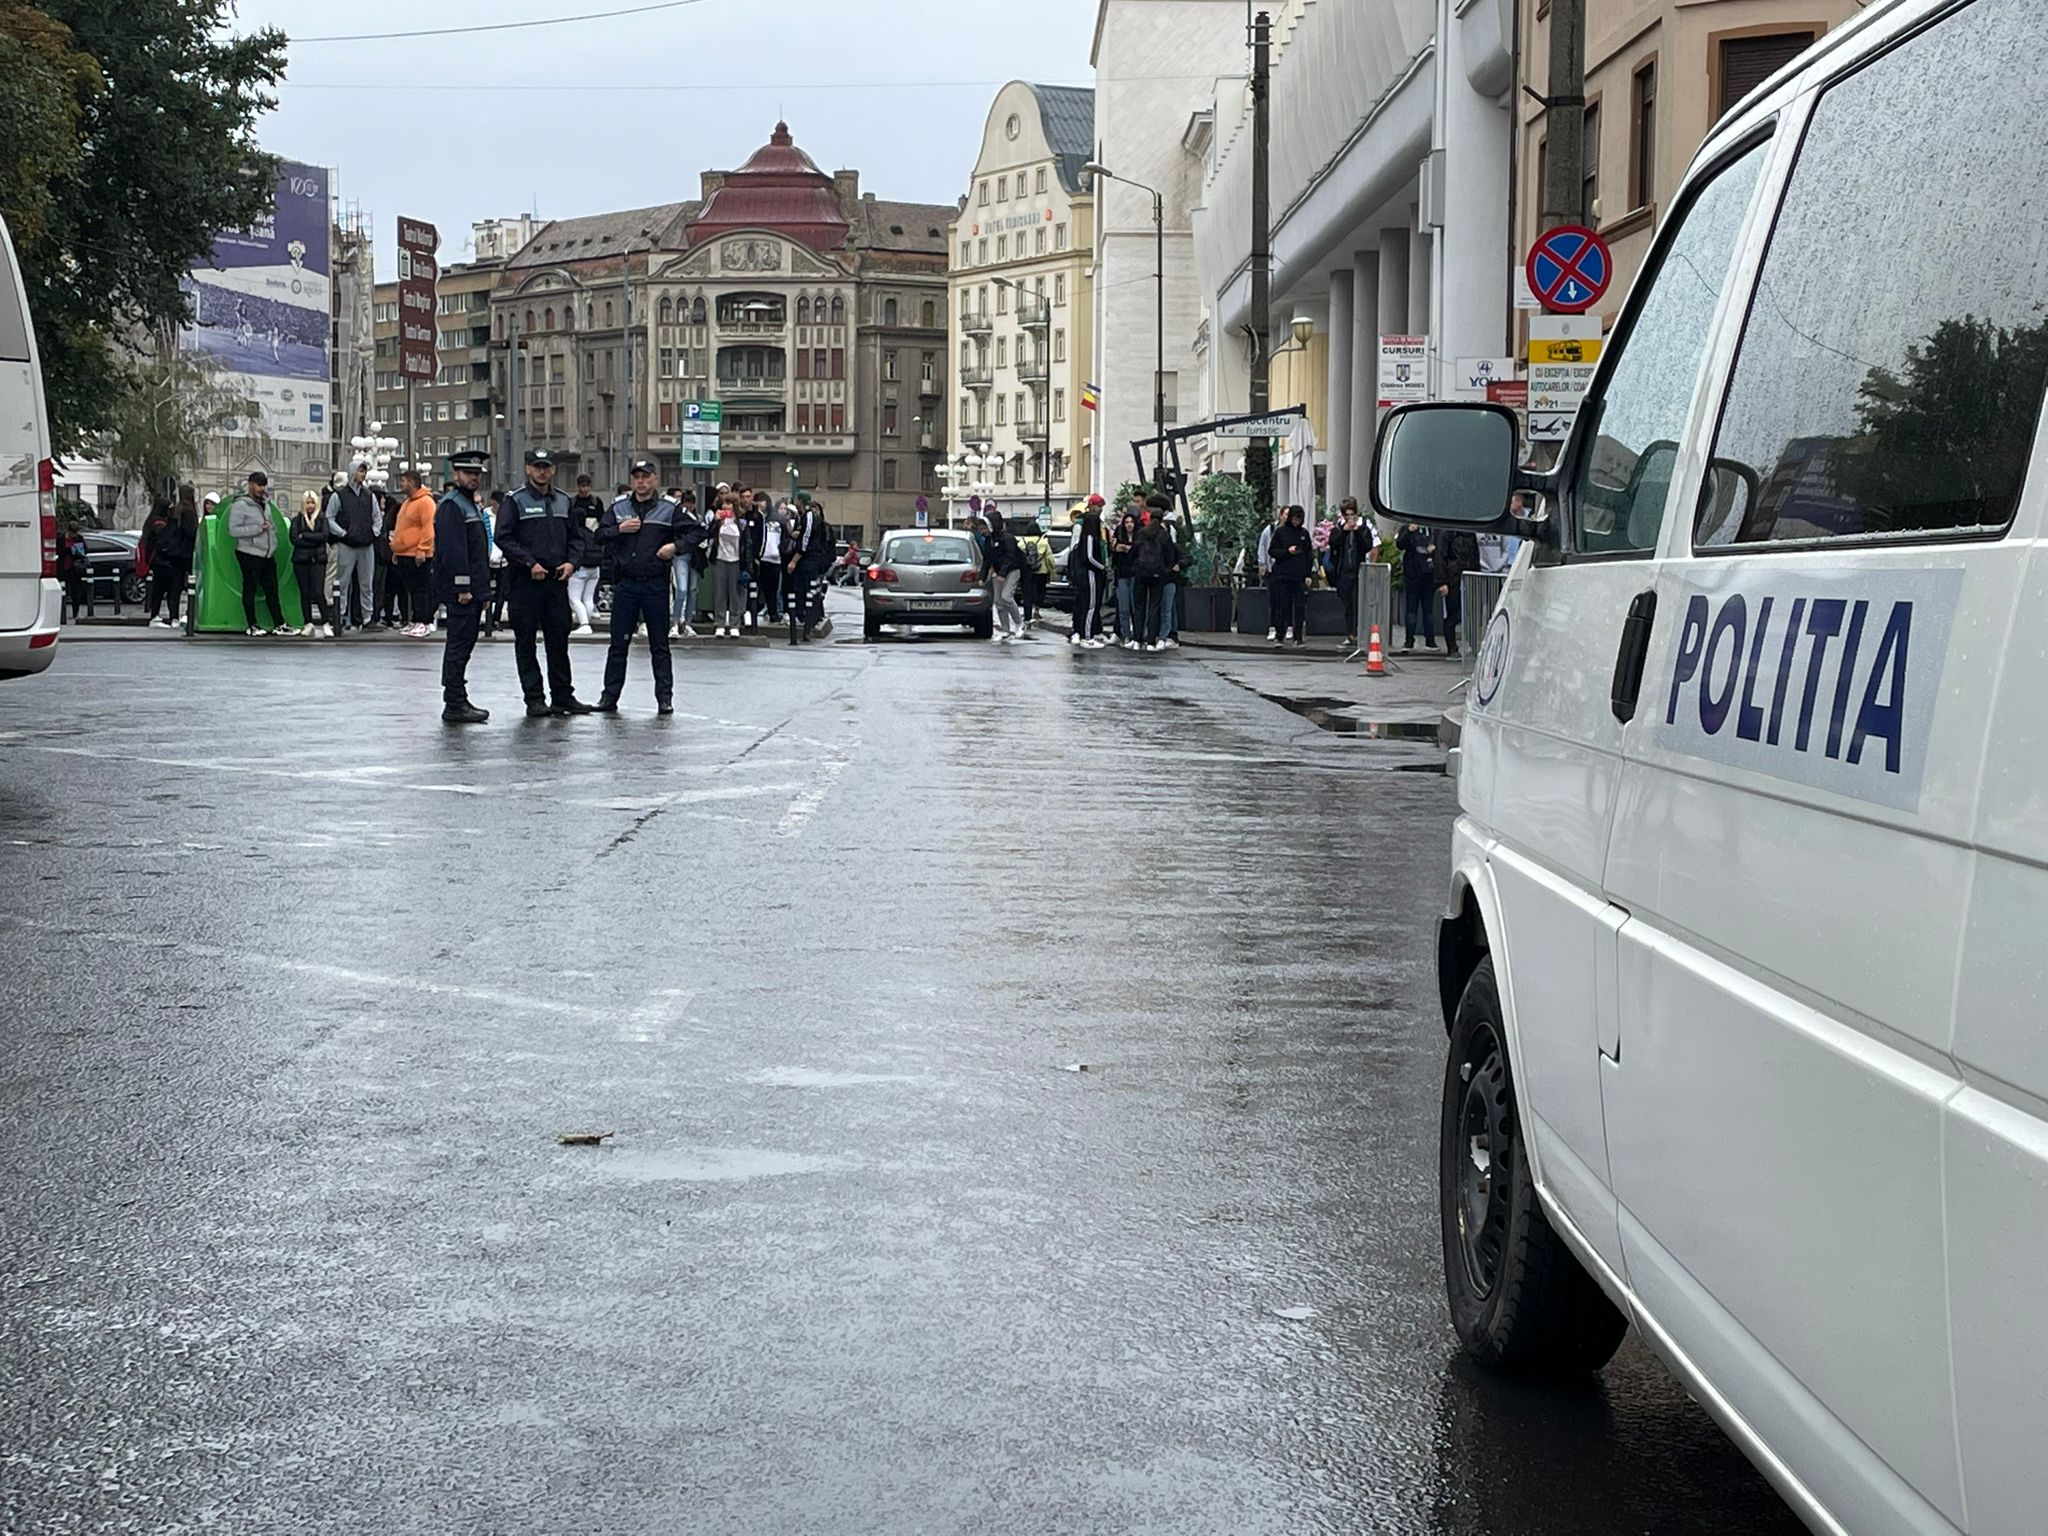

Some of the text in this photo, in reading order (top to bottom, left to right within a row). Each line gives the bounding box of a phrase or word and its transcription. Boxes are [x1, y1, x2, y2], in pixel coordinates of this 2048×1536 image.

[1480, 362, 1489, 373] 4
[688, 404, 699, 417] P
[1246, 425, 1280, 434] turistic
[1666, 593, 1913, 774] POLITIA
